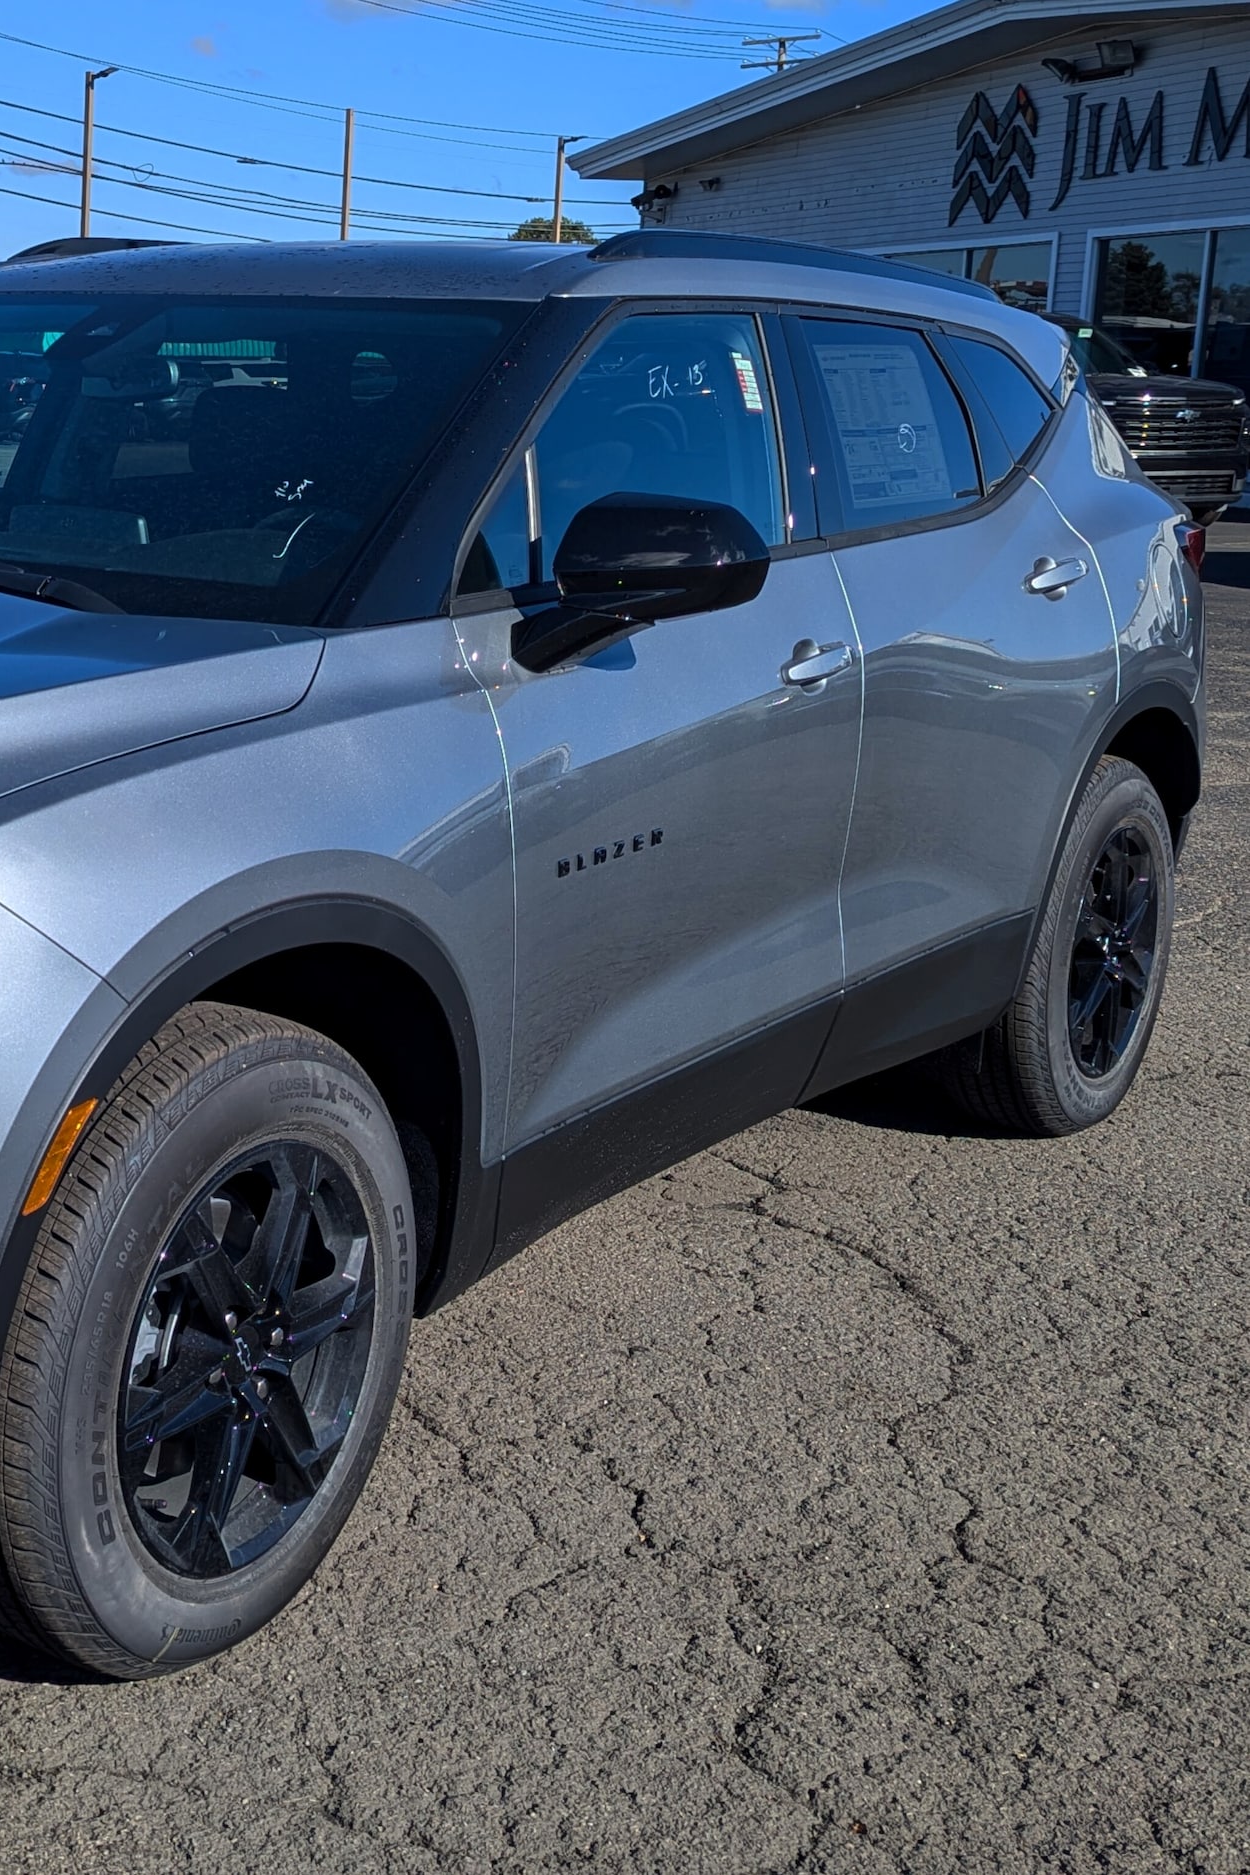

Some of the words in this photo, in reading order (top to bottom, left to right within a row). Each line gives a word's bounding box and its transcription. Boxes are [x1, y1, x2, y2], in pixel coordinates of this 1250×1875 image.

[1048, 92, 1168, 212] JIM
[557, 827, 664, 878] BLAZER
[270, 1091, 310, 1104] CONTACT
[311, 1077, 338, 1105] LX
[339, 1087, 372, 1120] SPORT
[115, 1228, 139, 1269] 106H
[392, 1204, 408, 1345] CROSS
